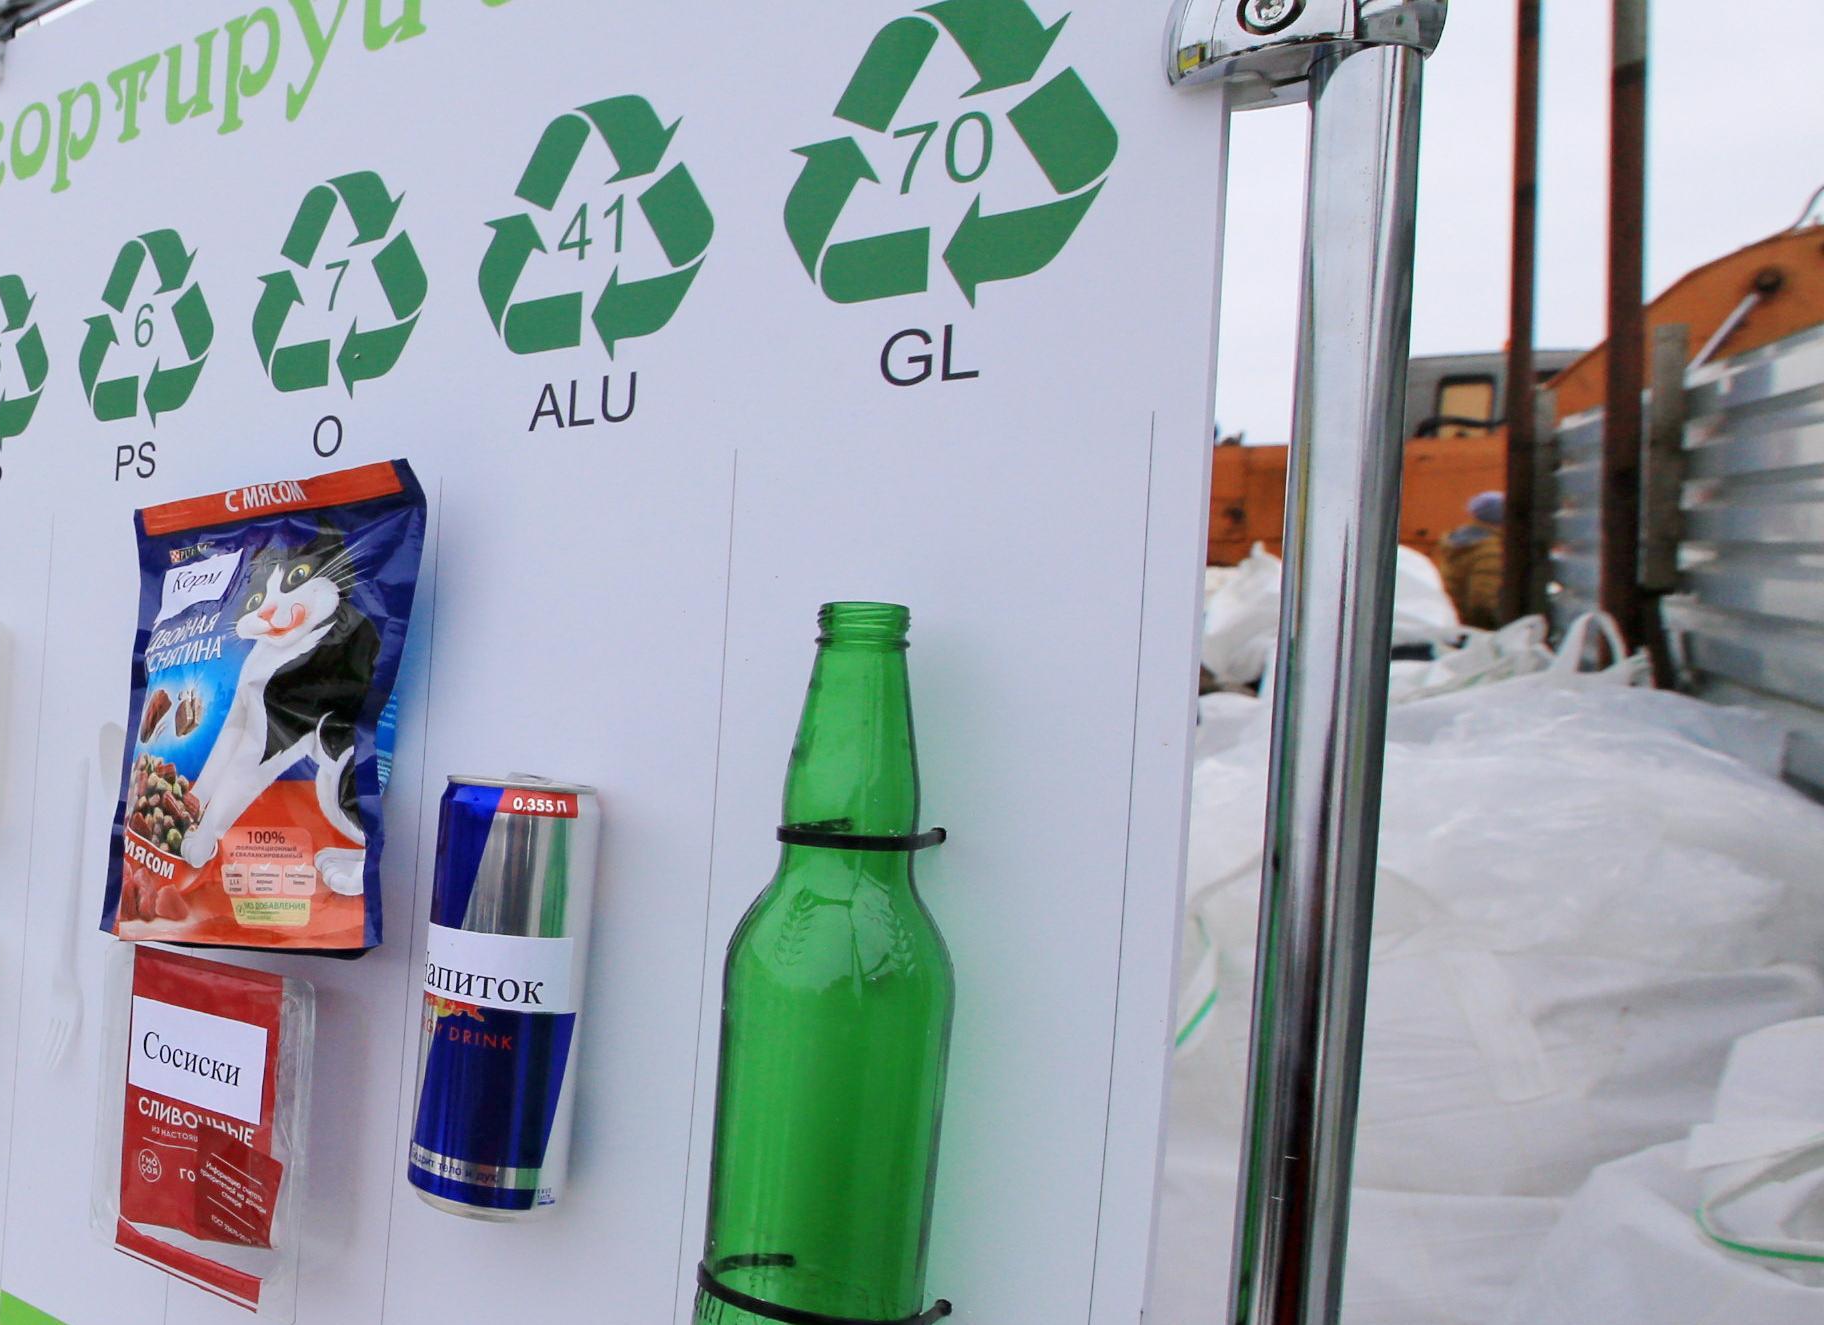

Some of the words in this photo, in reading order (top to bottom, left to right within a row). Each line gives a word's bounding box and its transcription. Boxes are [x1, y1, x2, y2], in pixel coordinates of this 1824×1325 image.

[892, 110, 993, 195] 70
[558, 194, 625, 261] 41
[325, 259, 350, 311] 7
[134, 303, 154, 347] 6
[879, 324, 980, 387] GL
[528, 371, 638, 432] ALU
[115, 441, 157, 482] PS
[225, 491, 239, 512] С
[243, 480, 307, 510] МЯСОМ
[172, 570, 223, 593] Корм
[124, 835, 175, 880] МЯСОМ
[248, 831, 285, 844] 100%
[143, 1031, 242, 1087] Сосиски
[449, 1026, 513, 1050] DRINK
[179, 1168, 196, 1182] ГО
[439, 1162, 462, 1176] тело
